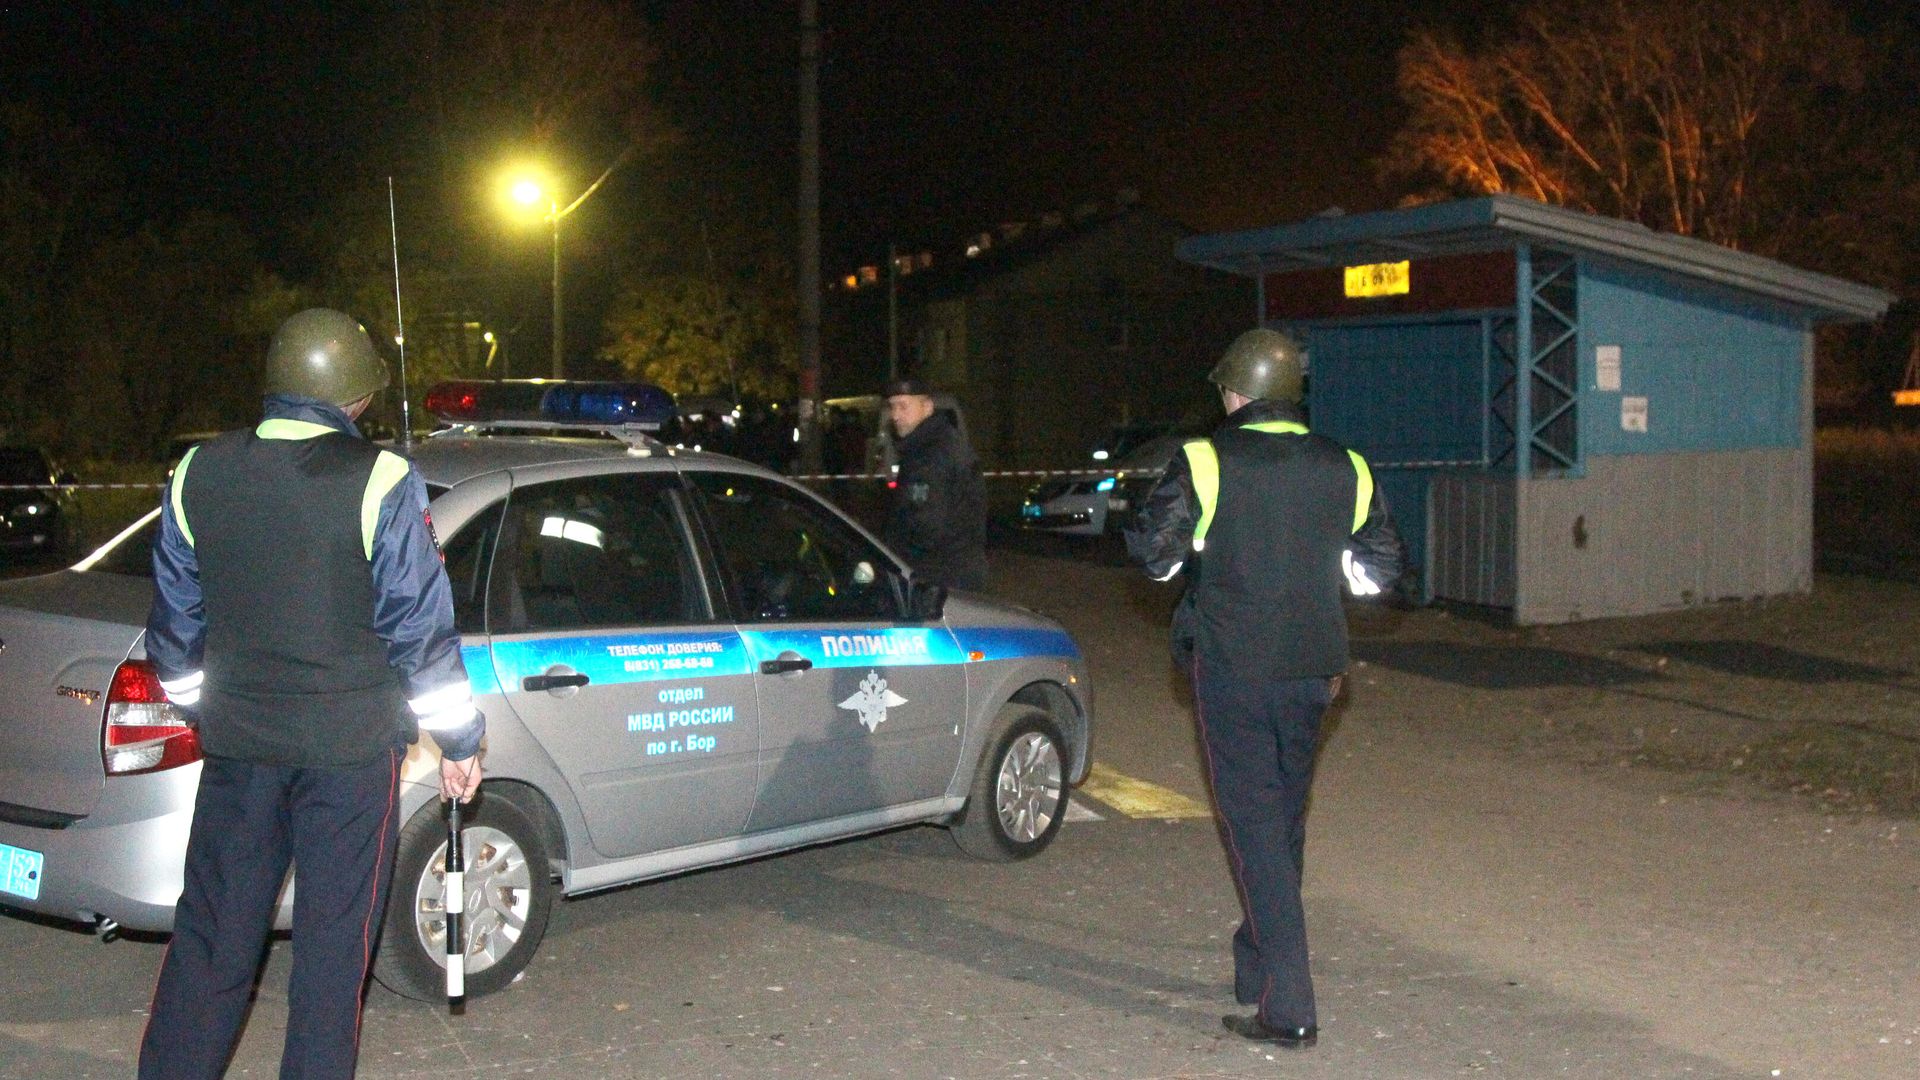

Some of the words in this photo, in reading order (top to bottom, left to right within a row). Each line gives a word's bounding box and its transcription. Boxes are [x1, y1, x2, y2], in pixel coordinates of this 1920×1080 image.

[607, 644, 664, 656] ТЕЛЕФОН
[667, 641, 723, 655] ДОВЕРИЯ:
[820, 635, 927, 657] ПОЛИЦИЯ
[658, 687, 704, 704] отдел
[627, 711, 665, 732] МВД
[669, 706, 733, 728] РОССИИ
[646, 741, 667, 755] по
[670, 740, 683, 753] г.
[686, 734, 716, 752] Бор
[13, 853, 37, 881] 52
